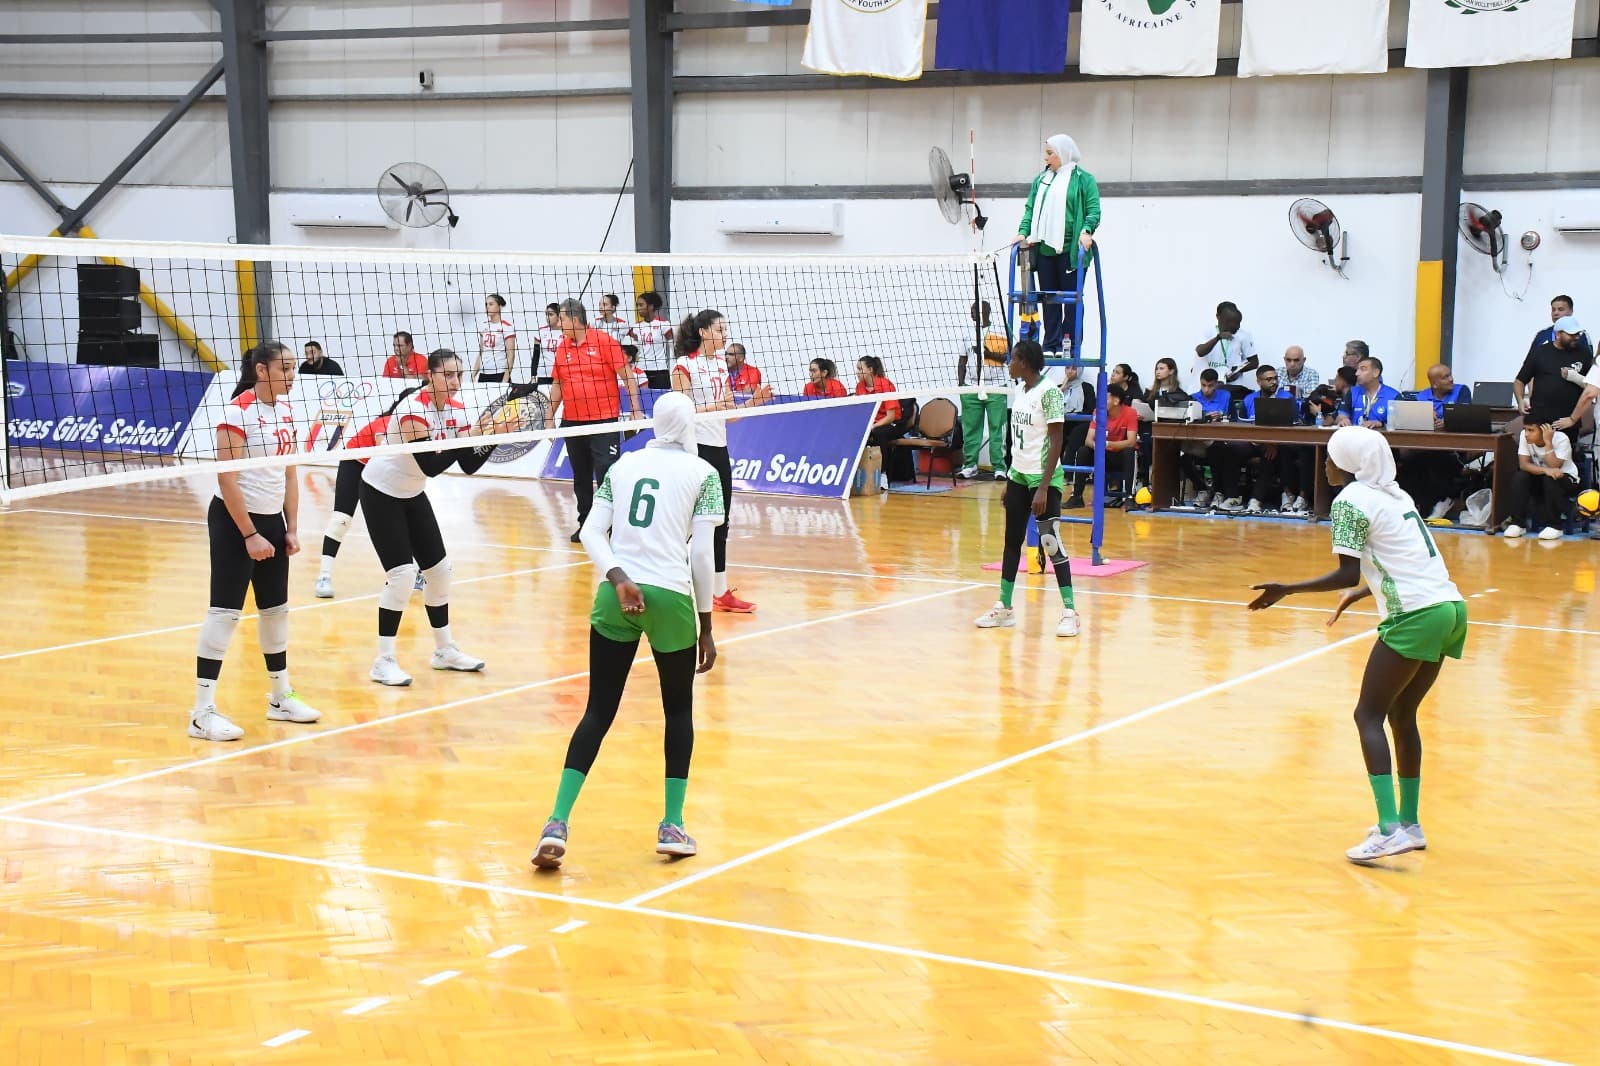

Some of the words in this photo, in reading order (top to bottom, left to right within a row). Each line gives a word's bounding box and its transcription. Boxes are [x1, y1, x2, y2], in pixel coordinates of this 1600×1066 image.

[1115, 12, 1183, 29] AFRICAINE
[53, 416, 103, 443] Girls
[104, 418, 182, 447] School
[766, 454, 848, 487] School
[628, 477, 660, 529] 6
[1402, 510, 1437, 558] 7
